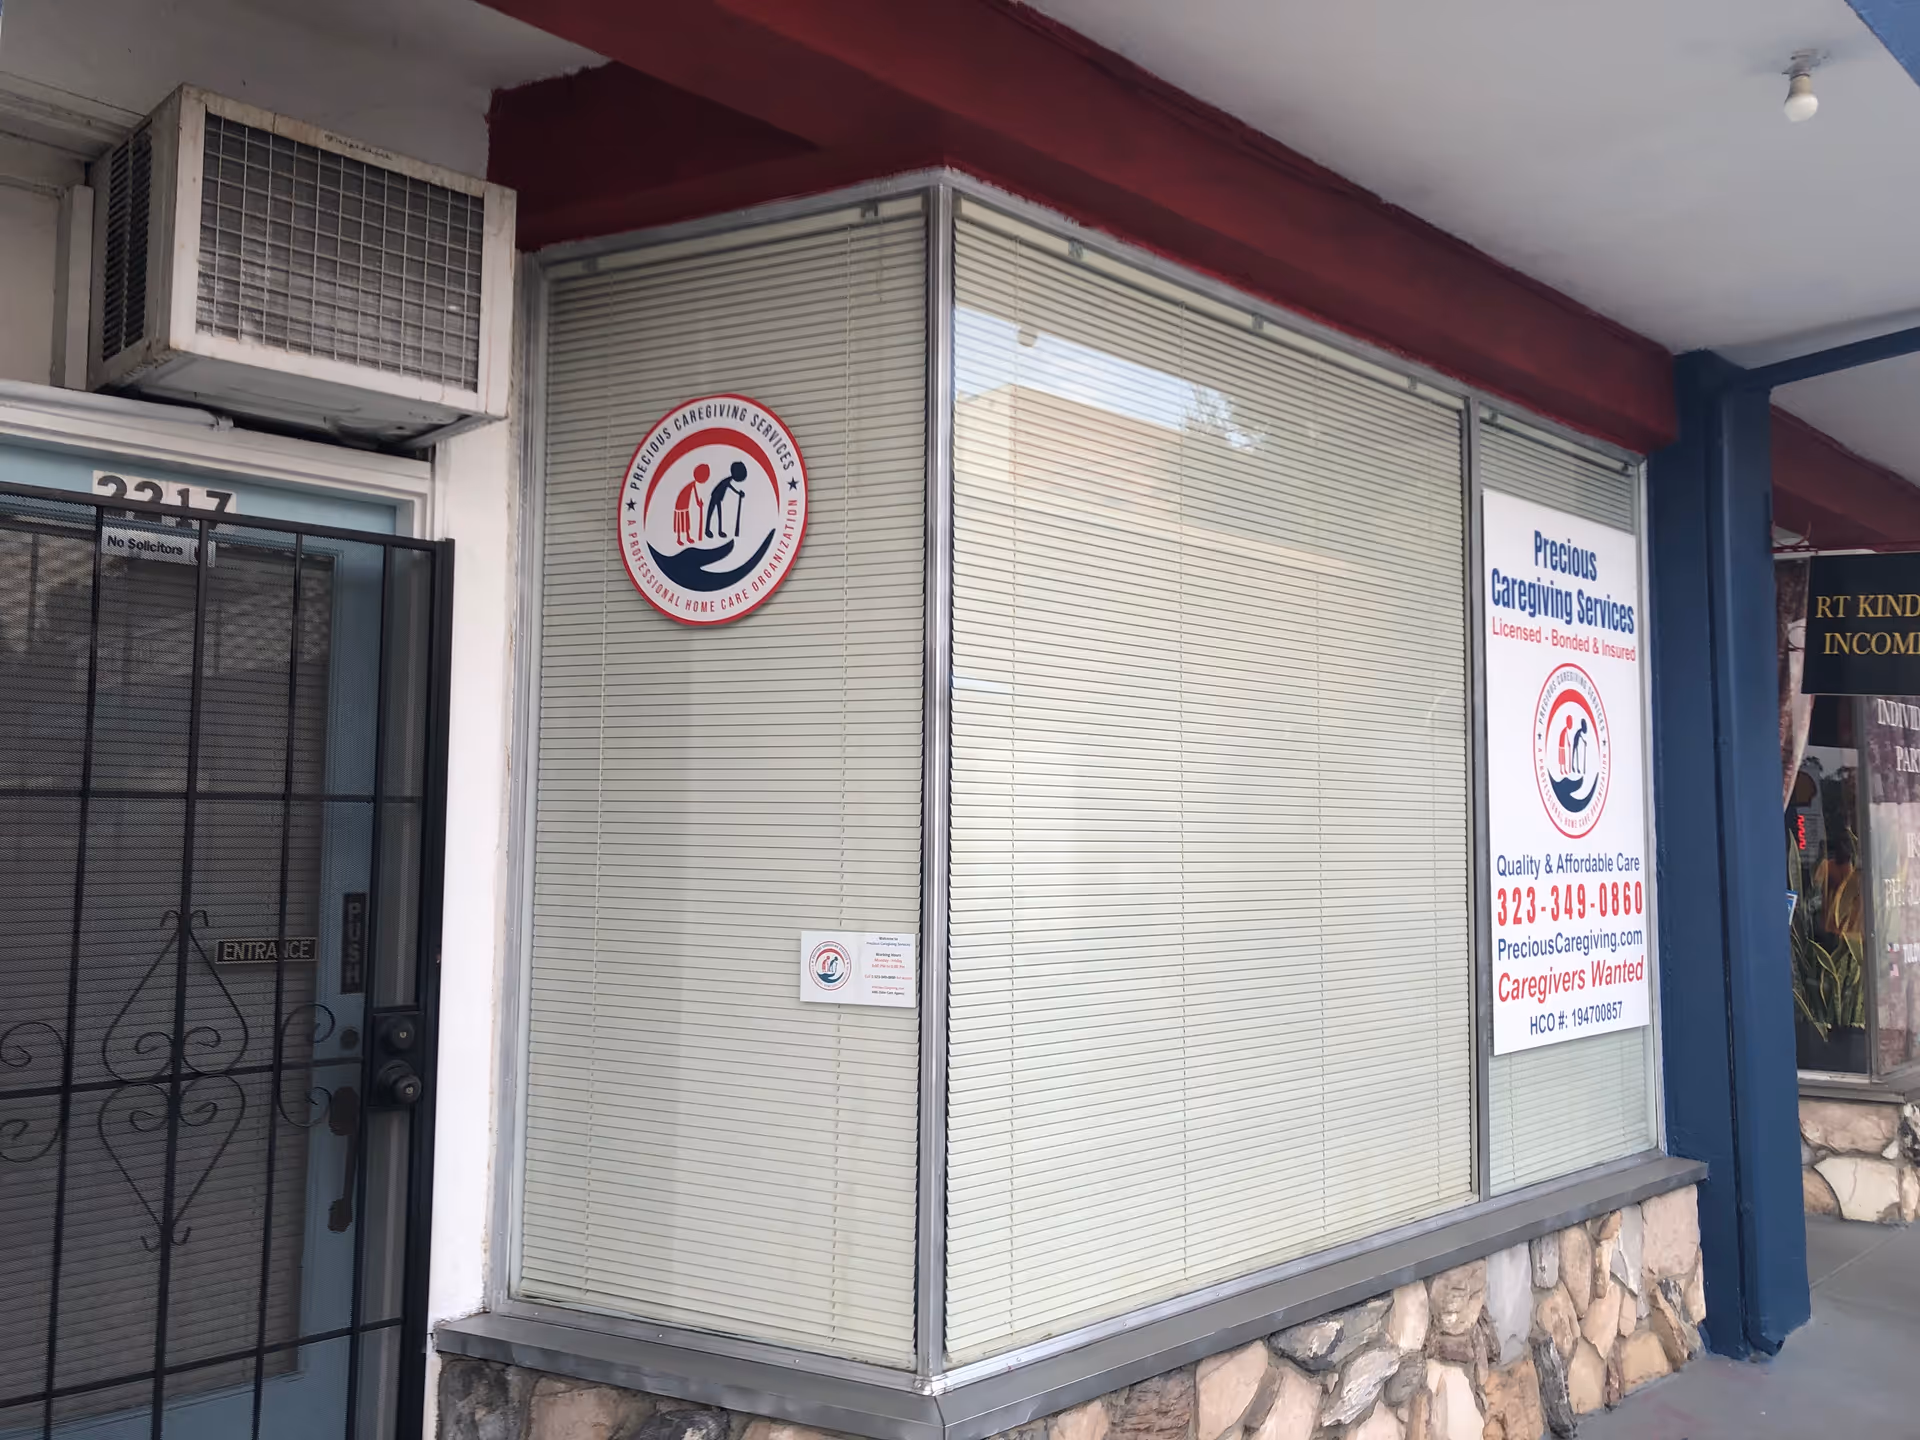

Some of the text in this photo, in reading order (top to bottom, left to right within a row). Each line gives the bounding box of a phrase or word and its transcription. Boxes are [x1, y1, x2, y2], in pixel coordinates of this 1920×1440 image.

[630, 403, 796, 491] PRECIOUS CAREGIVING SERVICES
[97, 475, 233, 531] 2217
[107, 535, 184, 556] No Solicitors
[626, 499, 798, 613] A PROFESSIONAL HOME CARE ORGANIZATION
[1534, 530, 1598, 582] Precious
[1491, 567, 1635, 635] Caregiving Services
[1815, 593, 1920, 618] RT KIND
[1492, 616, 1542, 644] Licensed
[1551, 629, 1590, 653] Bonded
[1592, 636, 1600, 655] &
[1601, 639, 1636, 662] Insured
[1823, 631, 1920, 656] INCOM
[1497, 852, 1641, 880] Quality & Affordable Care
[1497, 881, 1643, 926] 323-349-0860
[1498, 928, 1643, 961] PreciousCaregiving.com
[1498, 955, 1645, 1004] Caregivers Wanted
[1530, 1000, 1623, 1036] HCO #: 194700857
